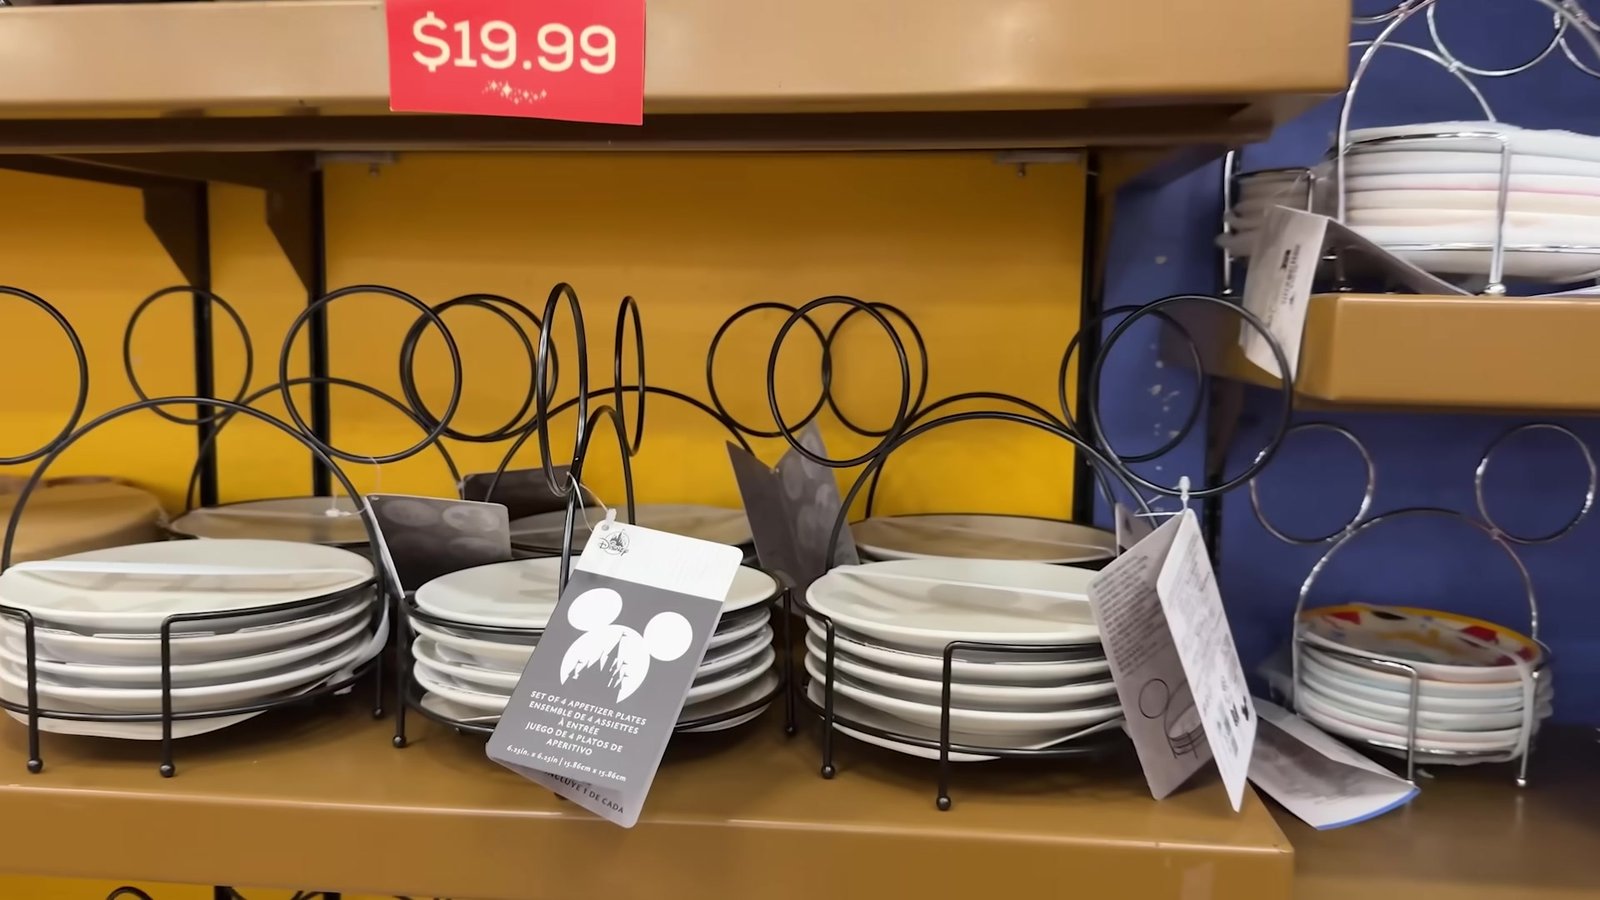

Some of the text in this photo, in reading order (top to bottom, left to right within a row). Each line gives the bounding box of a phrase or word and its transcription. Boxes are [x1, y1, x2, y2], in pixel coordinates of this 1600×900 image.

[412, 11, 617, 75] $19.99
[528, 701, 573, 717] ENSEMBLE
[573, 712, 587, 721] DE
[594, 717, 639, 735] ASSIETTES
[530, 690, 547, 700] SET
[547, 695, 560, 703] OF
[568, 700, 614, 717] APPETIZER
[615, 712, 647, 726] PLATES
[525, 721, 554, 735] JUEGO
[555, 729, 567, 738] DE
[576, 734, 610, 749] PLATOS
[610, 743, 623, 753] DE
[558, 717, 600, 735] À ENTRÉE
[546, 738, 593, 756] APERITIVO
[536, 752, 558, 763] 6.25in
[564, 760, 591, 773] 15.86cm
[598, 770, 627, 782] 15.86cm
[589, 791, 600, 801] DE
[601, 798, 624, 814] CADA
